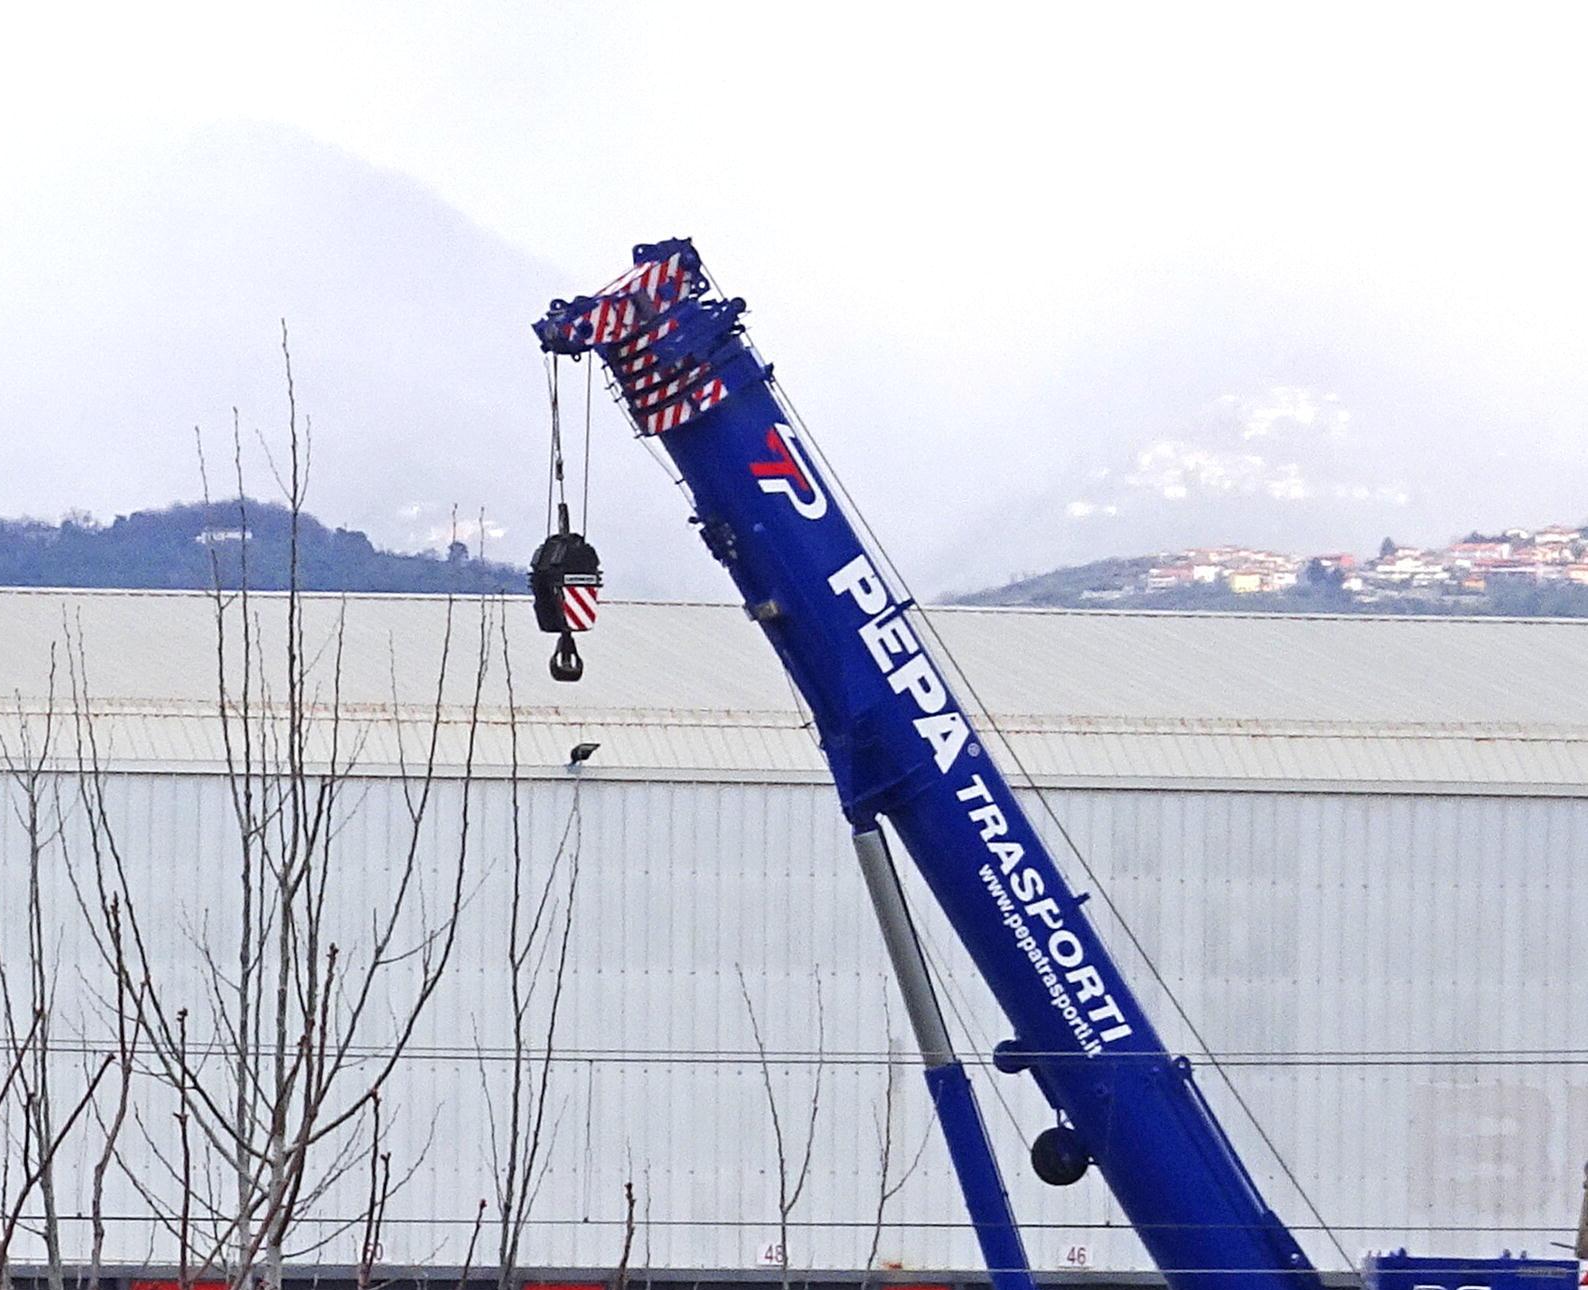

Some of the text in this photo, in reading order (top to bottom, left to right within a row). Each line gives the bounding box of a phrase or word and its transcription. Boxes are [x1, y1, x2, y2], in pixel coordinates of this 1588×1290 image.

[956, 774, 1133, 1043] TRASPORTI
[978, 863, 1104, 1058] www.pepatrasporti.it
[764, 1244, 785, 1263] 48
[1067, 1246, 1087, 1265] 46
